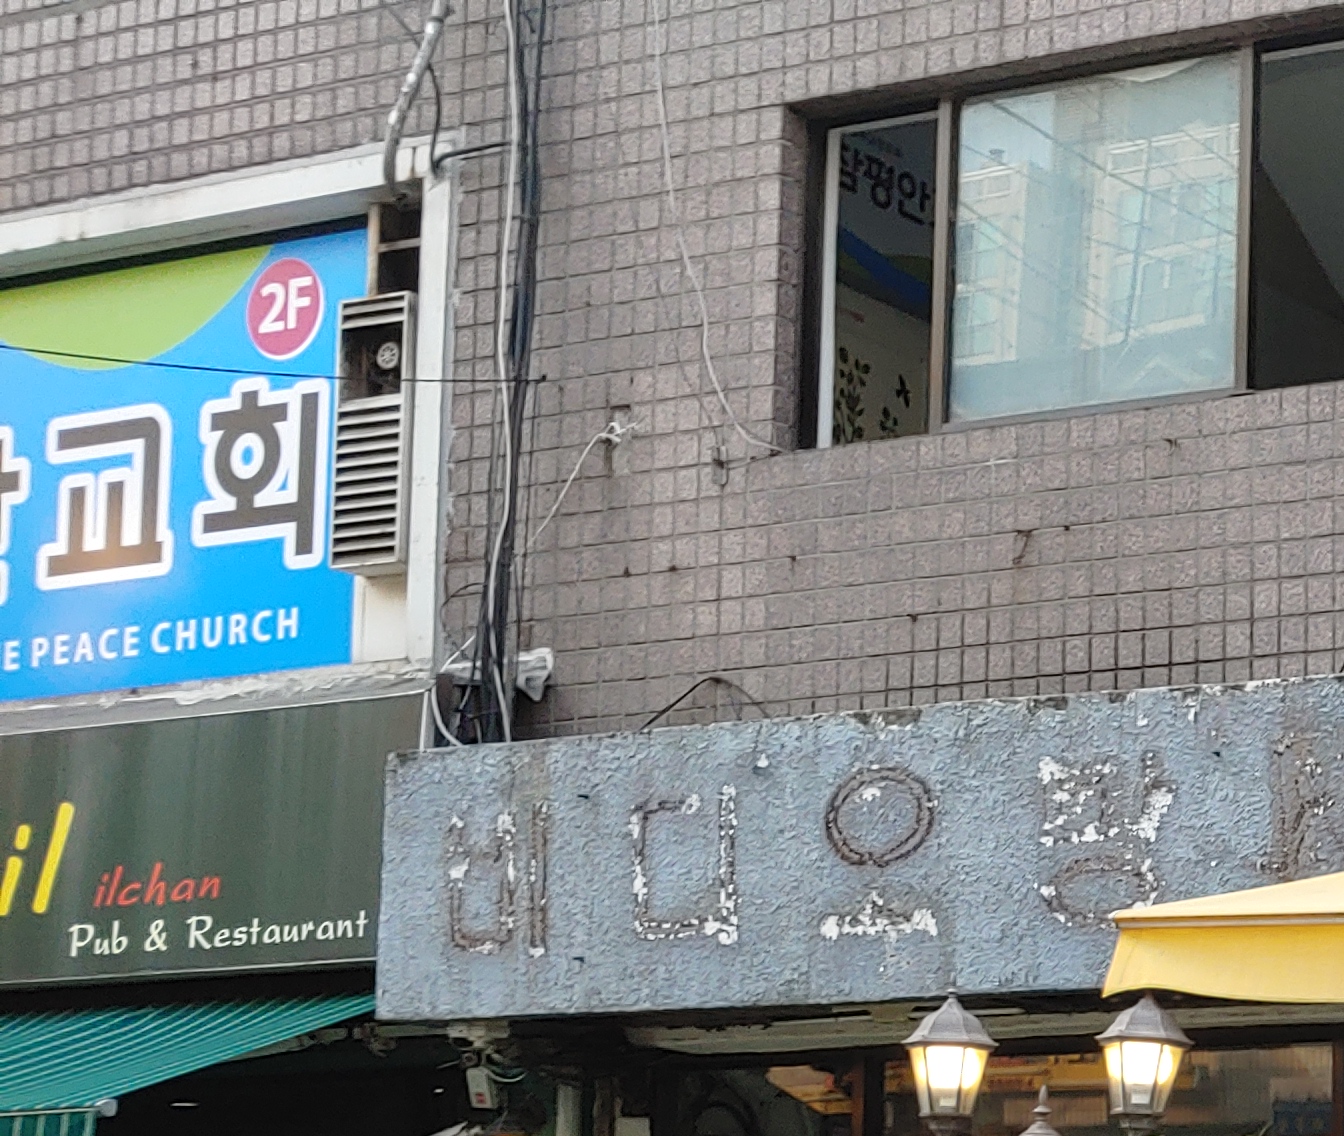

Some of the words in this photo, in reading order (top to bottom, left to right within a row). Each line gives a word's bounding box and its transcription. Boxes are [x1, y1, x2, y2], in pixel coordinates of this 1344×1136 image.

[257, 273, 314, 336] 2F
[30, 626, 140, 668] PEACE
[151, 607, 300, 653] CHURCH
[94, 862, 222, 908] ilchan
[68, 920, 129, 958] Pub
[144, 919, 169, 952] &
[185, 910, 370, 951] Restaurant
